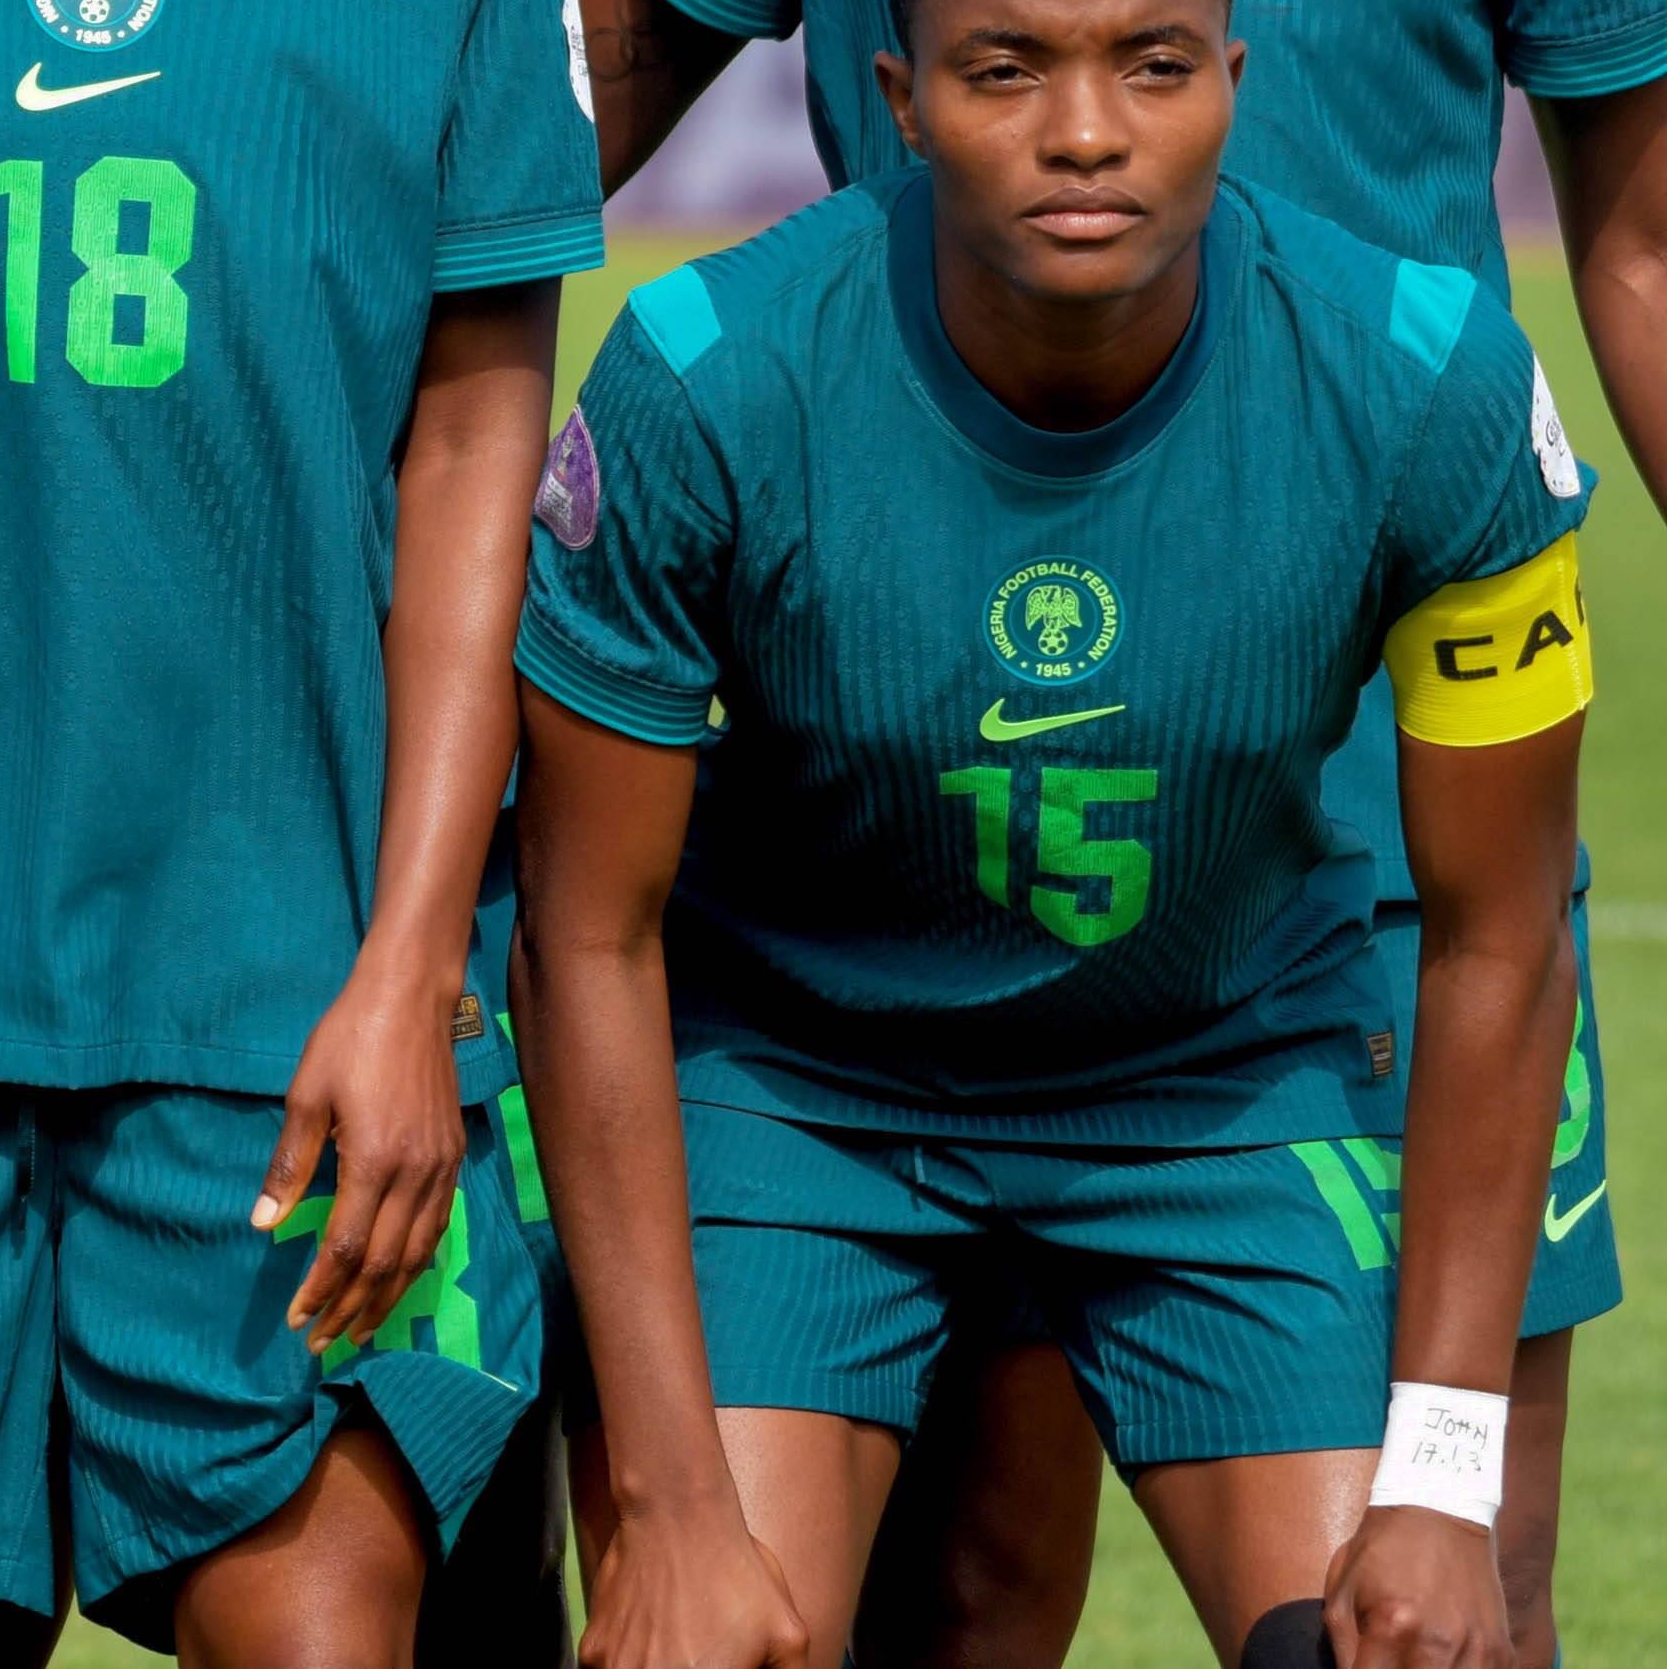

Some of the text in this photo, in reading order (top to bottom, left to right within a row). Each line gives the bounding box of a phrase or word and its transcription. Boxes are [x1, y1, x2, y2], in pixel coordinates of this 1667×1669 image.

[75, 29, 111, 44] 1945
[990, 562, 1117, 661] NIGERIA FOOTBALL FEDERATION
[1434, 577, 1584, 681] CA
[1035, 663, 1072, 677] 1945
[940, 765, 1157, 947] 15
